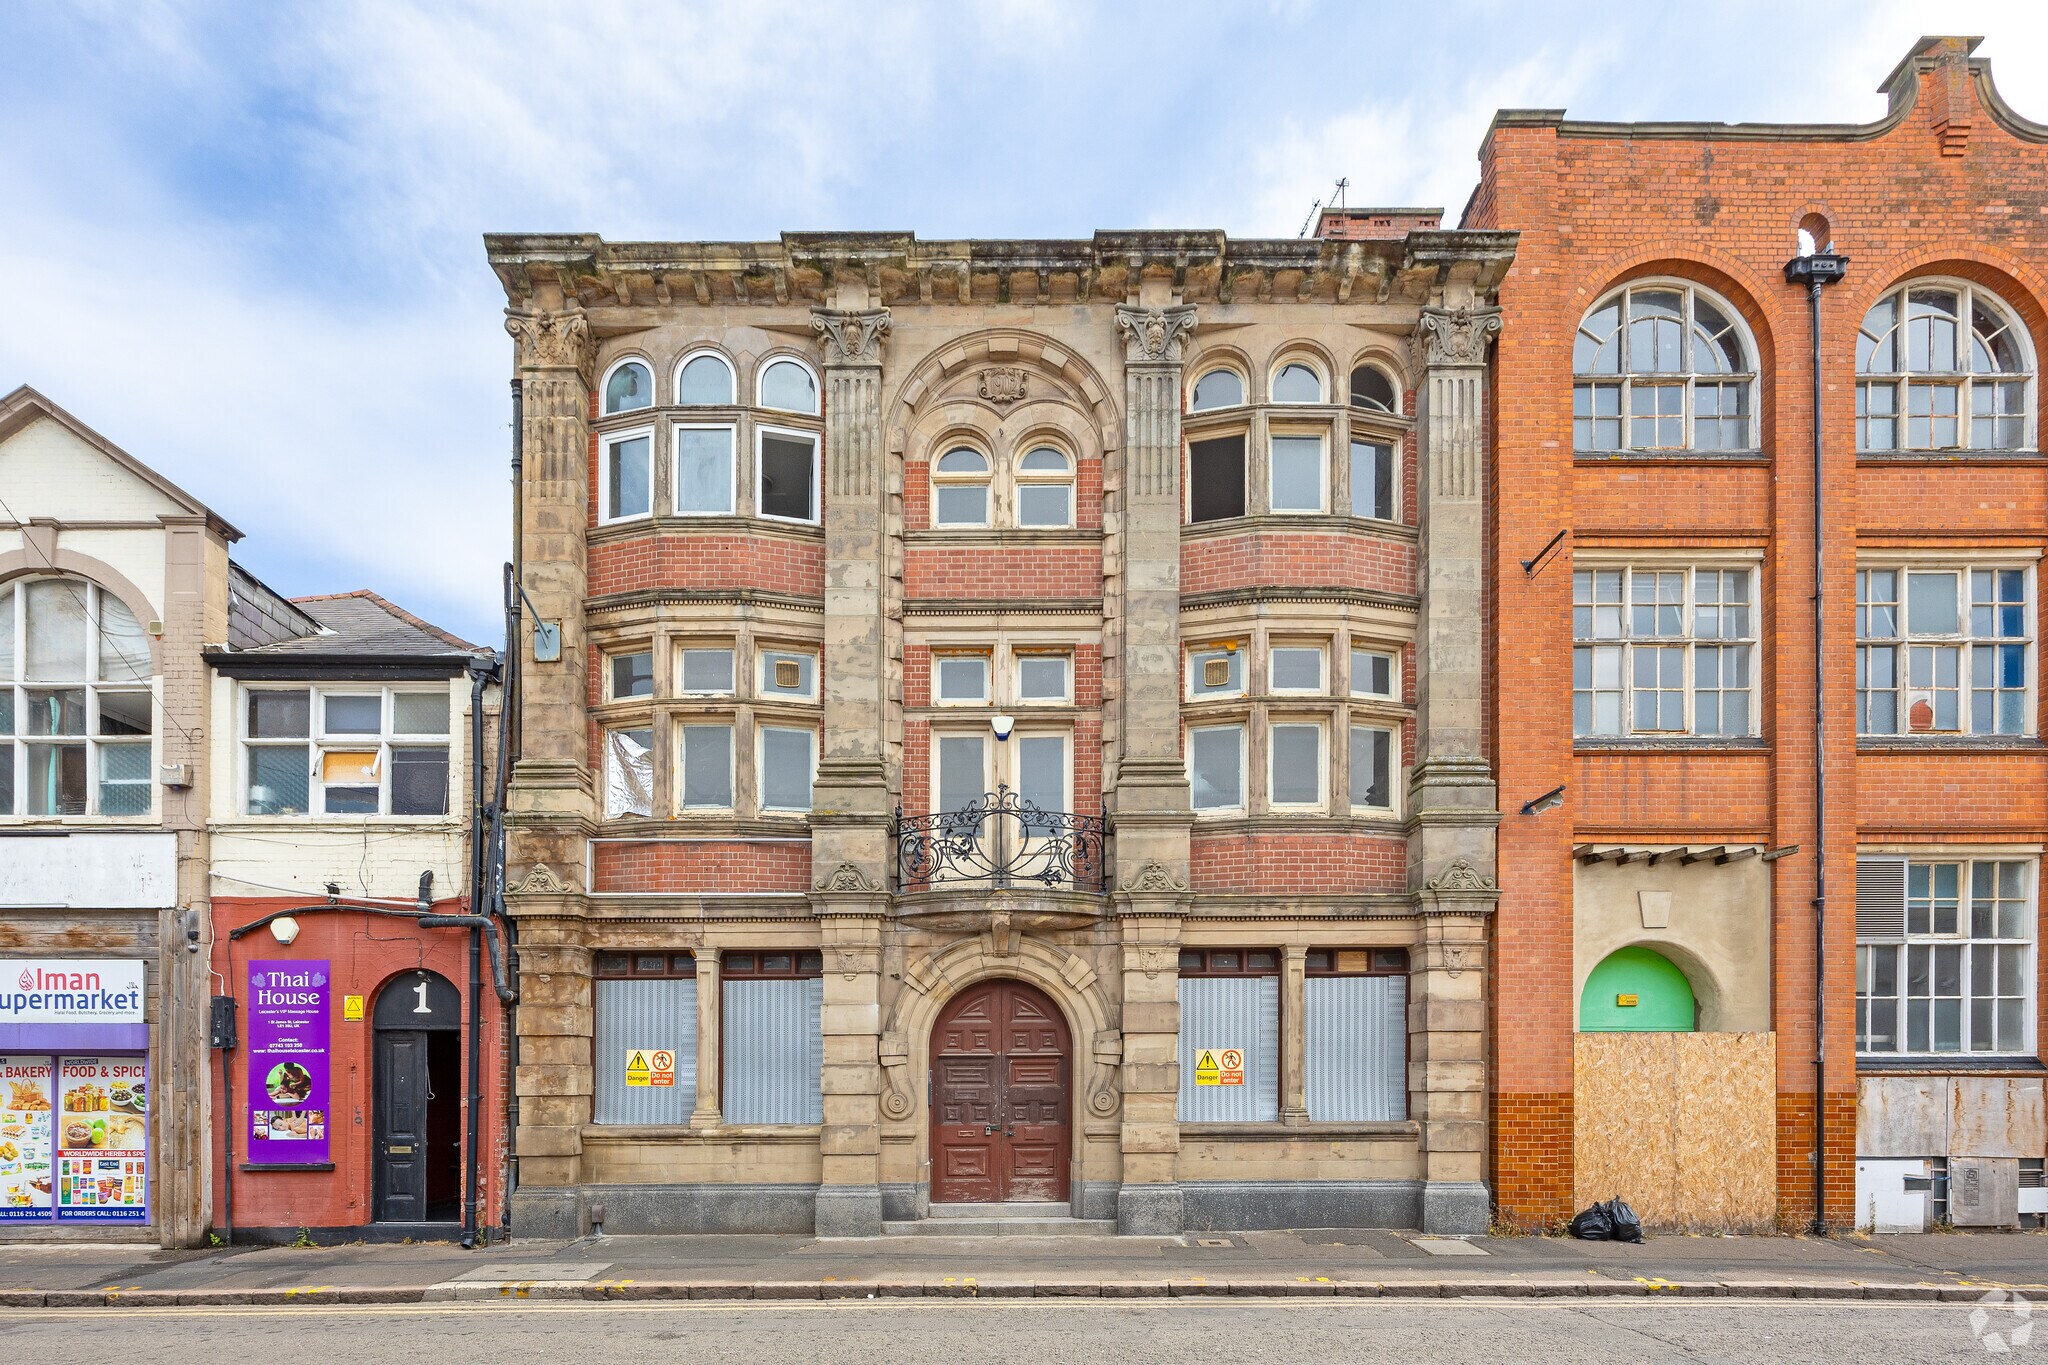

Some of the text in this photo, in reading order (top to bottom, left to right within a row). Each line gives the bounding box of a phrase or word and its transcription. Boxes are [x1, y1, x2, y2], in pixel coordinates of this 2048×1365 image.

[37, 968, 100, 990] Iman
[267, 971, 309, 987] Thai
[258, 990, 320, 1005] House
[413, 982, 431, 1012] 1
[6, 1067, 51, 1078] BAKERY
[63, 1066, 96, 1077] FOOD
[101, 1066, 109, 1077] &
